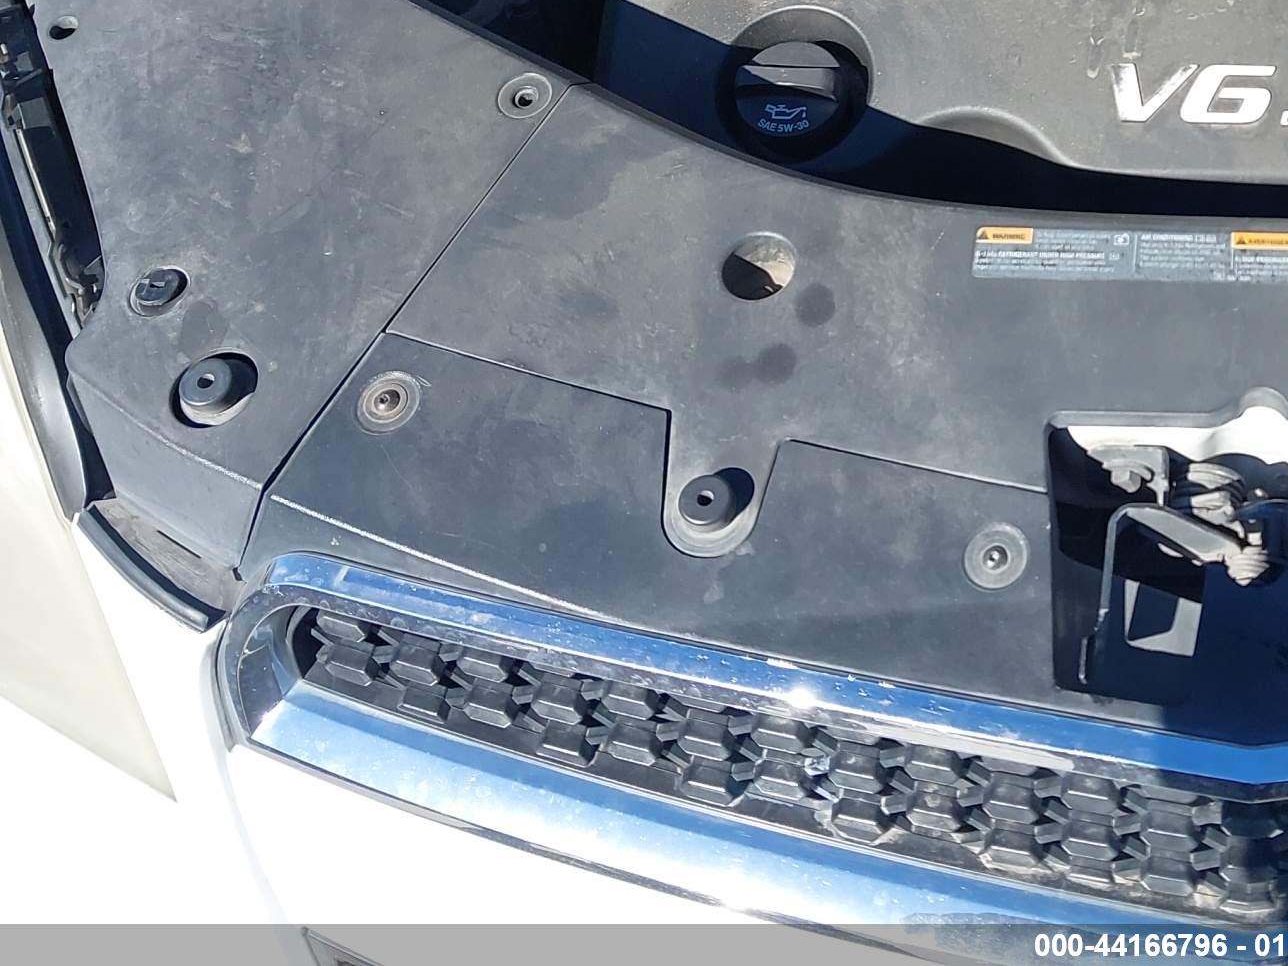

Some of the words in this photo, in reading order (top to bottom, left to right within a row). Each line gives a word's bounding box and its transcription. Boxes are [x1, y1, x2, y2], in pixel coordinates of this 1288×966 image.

[1109, 62, 1278, 125] V6
[758, 118, 777, 132] SAE
[777, 120, 809, 132] 5W-30
